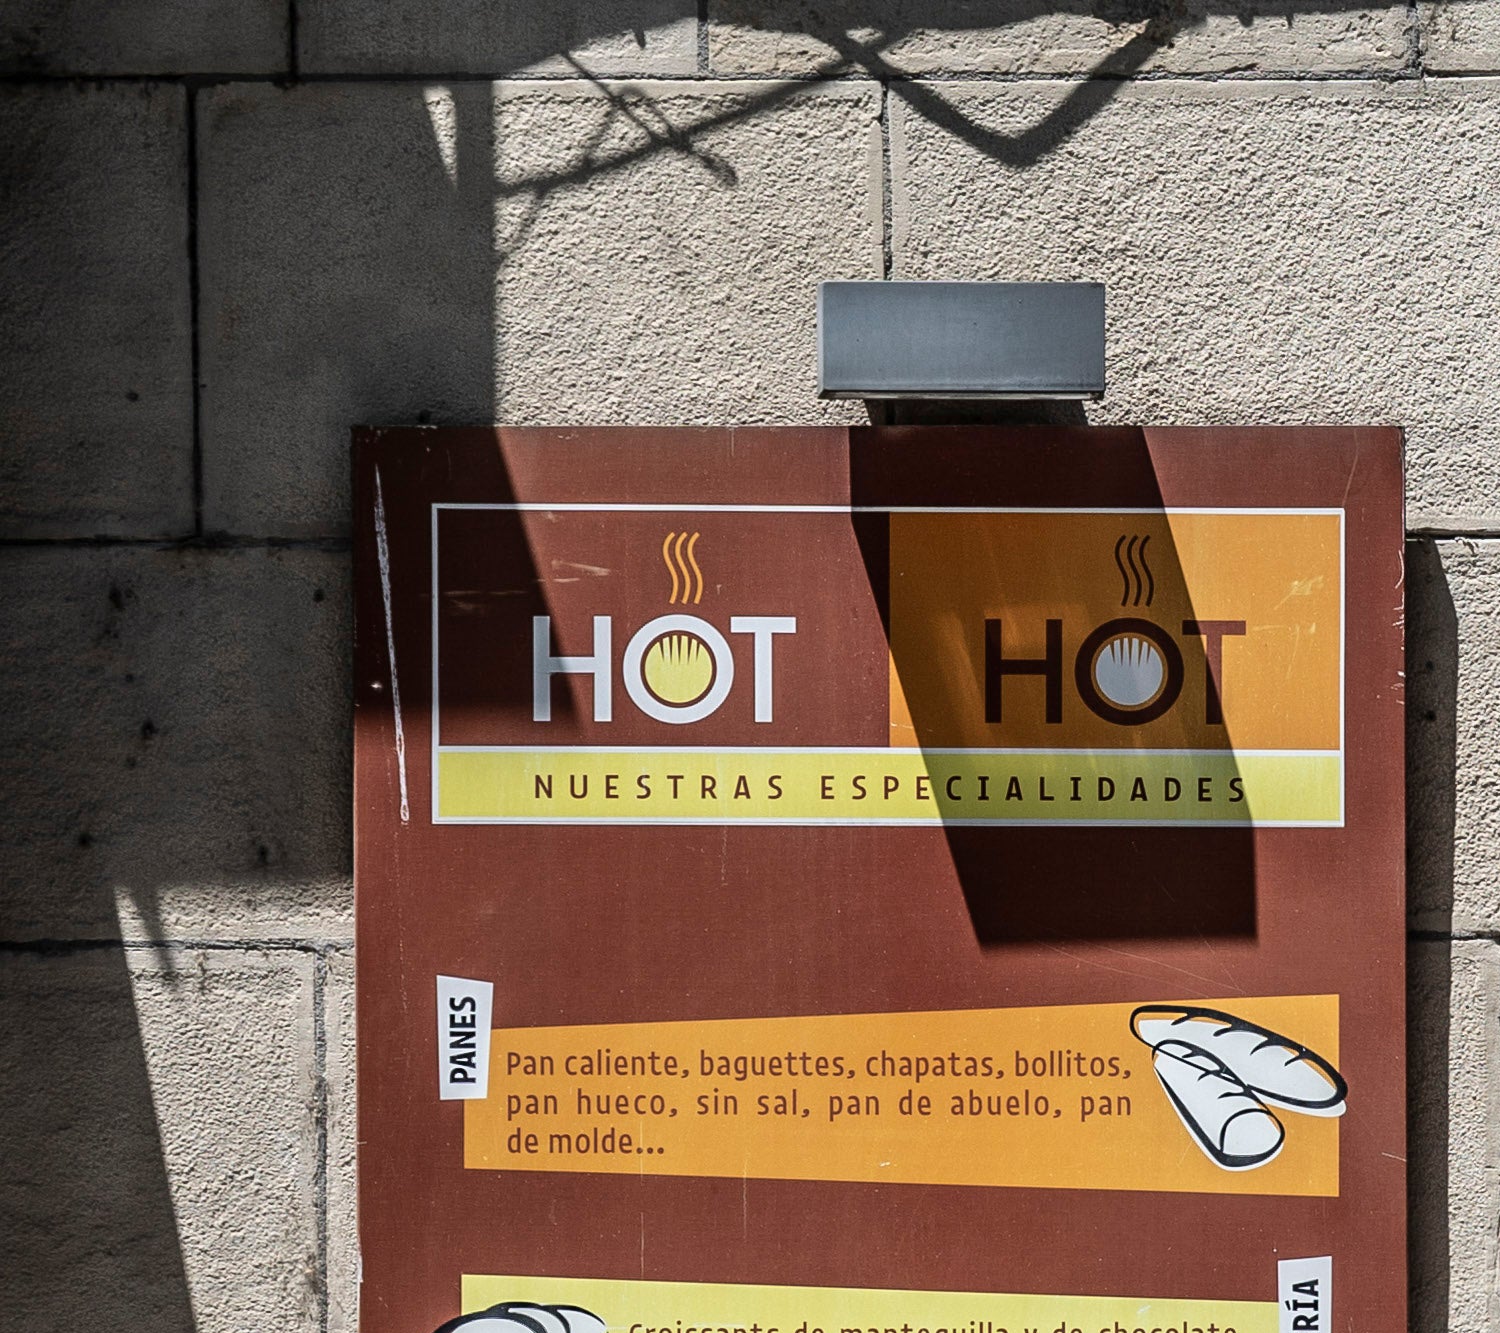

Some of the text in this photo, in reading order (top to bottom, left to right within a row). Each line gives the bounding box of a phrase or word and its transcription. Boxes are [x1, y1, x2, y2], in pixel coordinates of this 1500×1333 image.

[532, 615, 797, 725] HOT
[984, 617, 1246, 727] HOT
[534, 773, 1248, 804] NUESTRAS ESPECIALIDADES
[449, 995, 477, 1084] PANES
[507, 1048, 1131, 1084] Pan caliente, baguettes, chapatas, bollitos,
[507, 1087, 1131, 1123] pan hueco, sin sal, pan de abuelo, pan
[507, 1126, 665, 1155] de molde...
